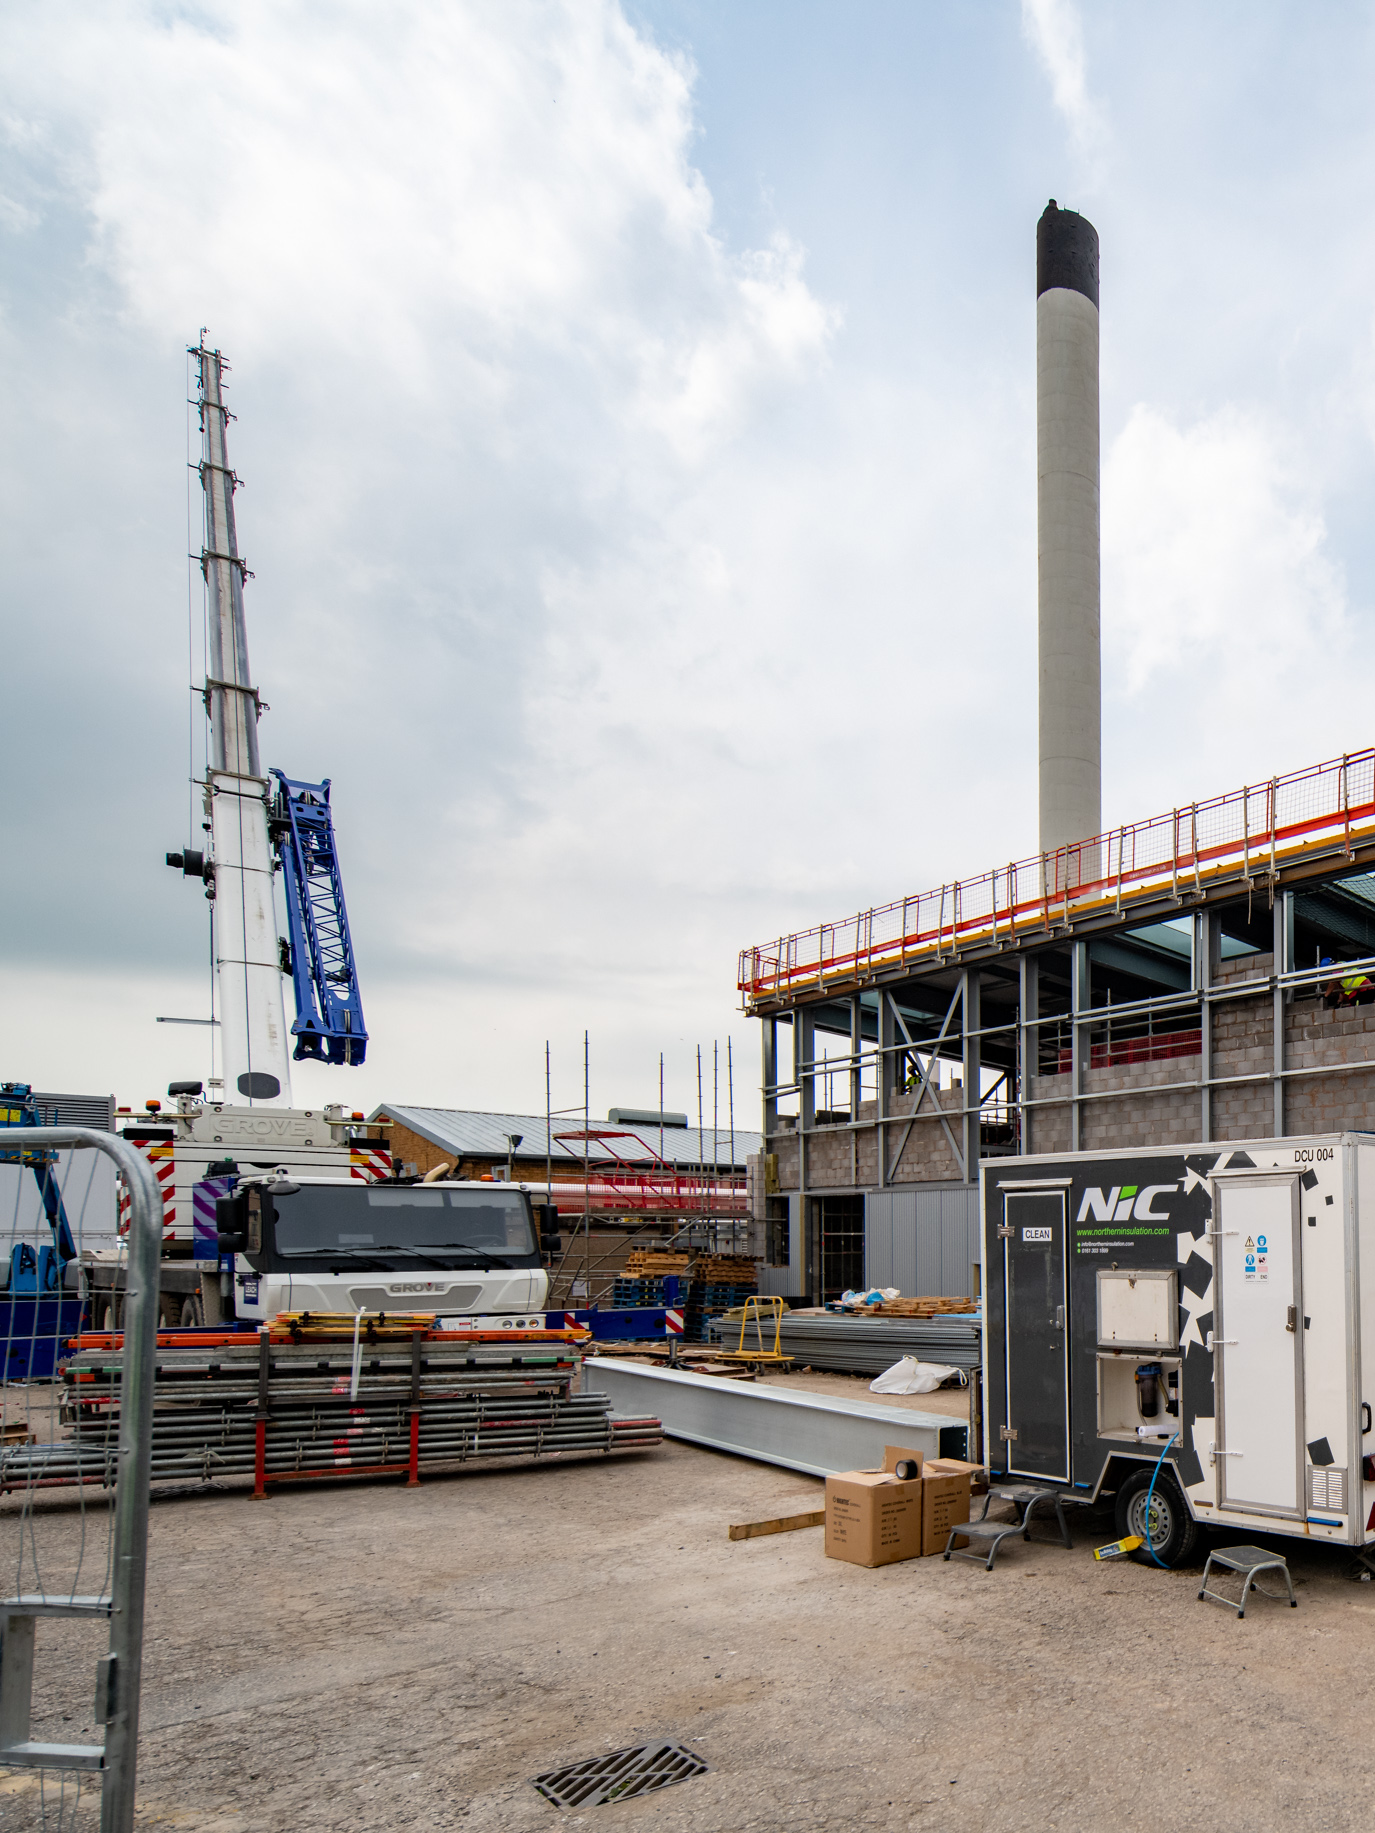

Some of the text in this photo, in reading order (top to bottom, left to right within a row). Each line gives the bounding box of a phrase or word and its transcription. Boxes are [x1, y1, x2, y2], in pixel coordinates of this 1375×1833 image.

[213, 1119, 307, 1136] GROVE
[1294, 1148, 1334, 1162] DCU 004
[1025, 1229, 1050, 1239] CLEAN
[1076, 1226, 1170, 1236] www.northerninsulation.com
[390, 1282, 445, 1293] GROVE
